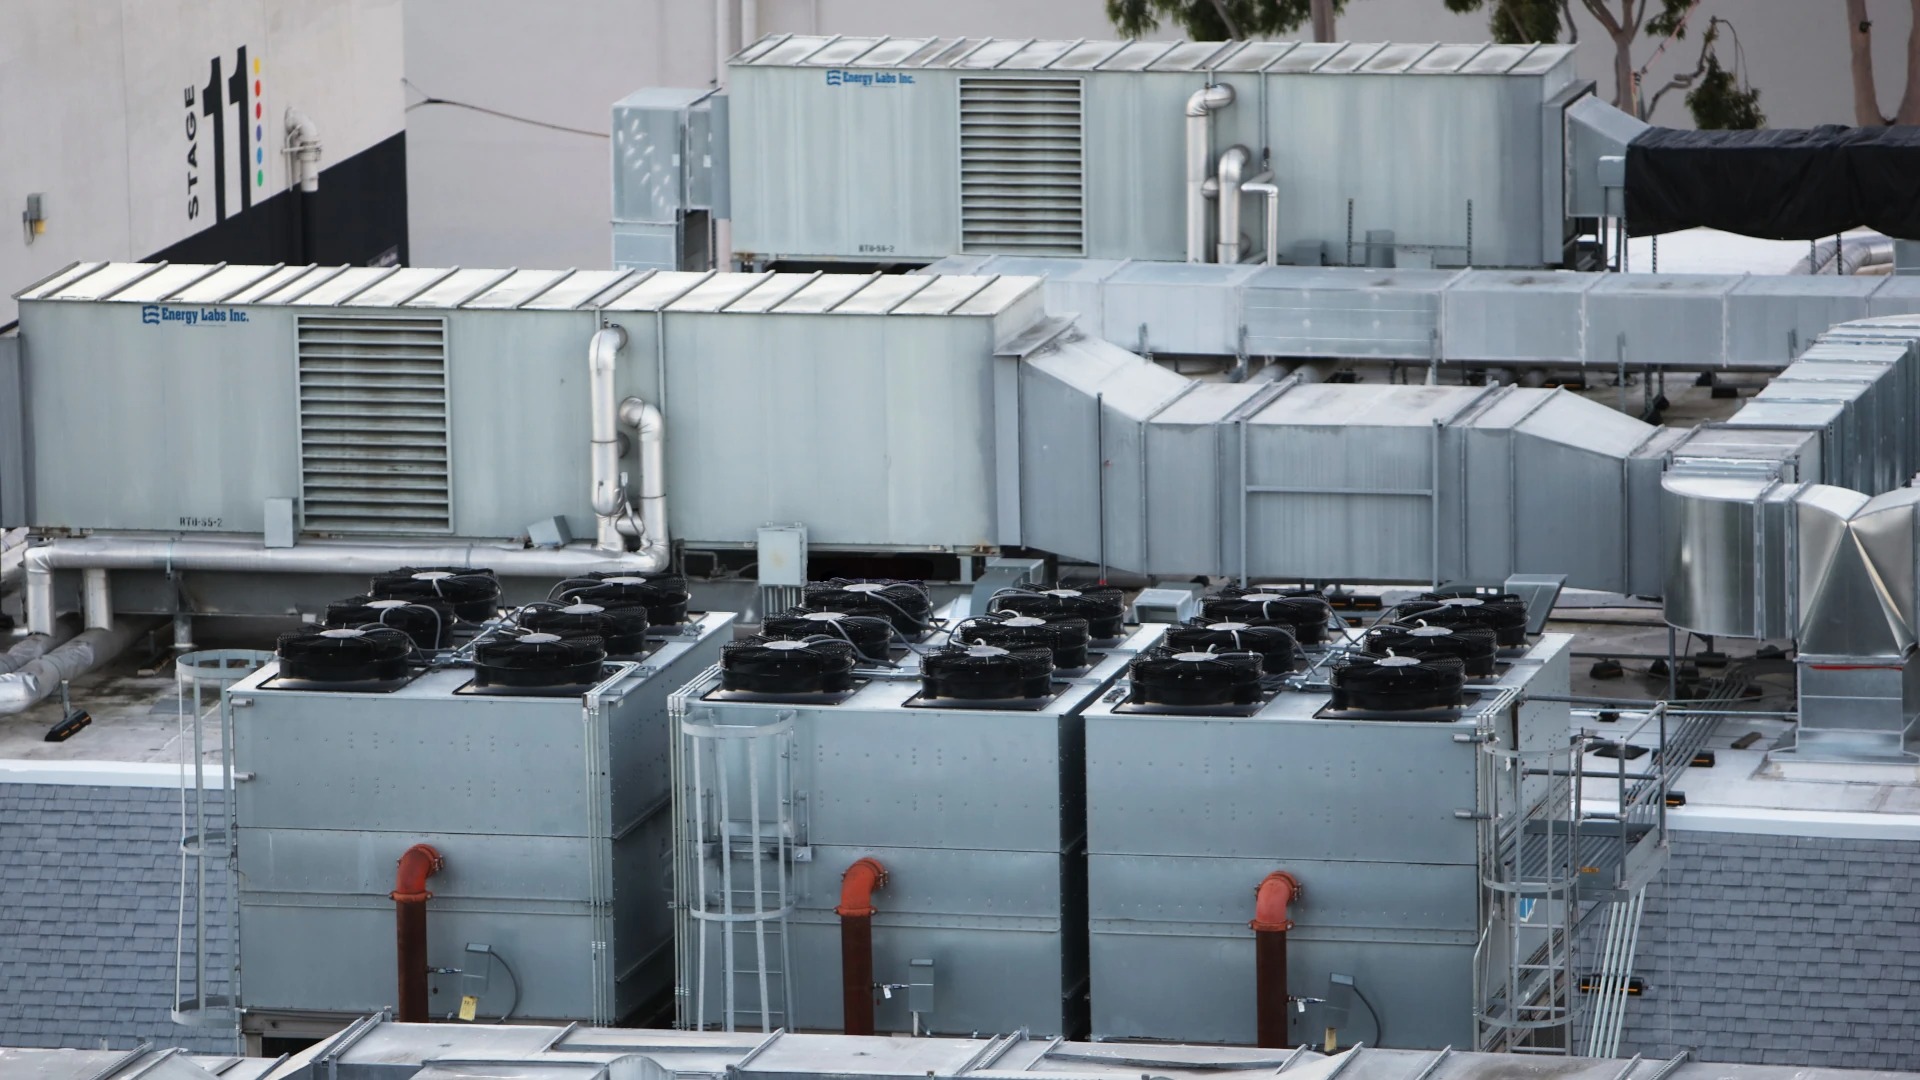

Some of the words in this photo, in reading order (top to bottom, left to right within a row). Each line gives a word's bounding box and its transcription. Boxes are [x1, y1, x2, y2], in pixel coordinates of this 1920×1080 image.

[843, 71, 873, 86] Energy
[875, 72, 896, 83] Labs
[899, 72, 915, 84] Inc.
[184, 85, 199, 221] STAGE
[203, 44, 251, 225] 11
[161, 307, 198, 324] Energy
[201, 308, 227, 321] Labs
[229, 308, 249, 322] Inc.
